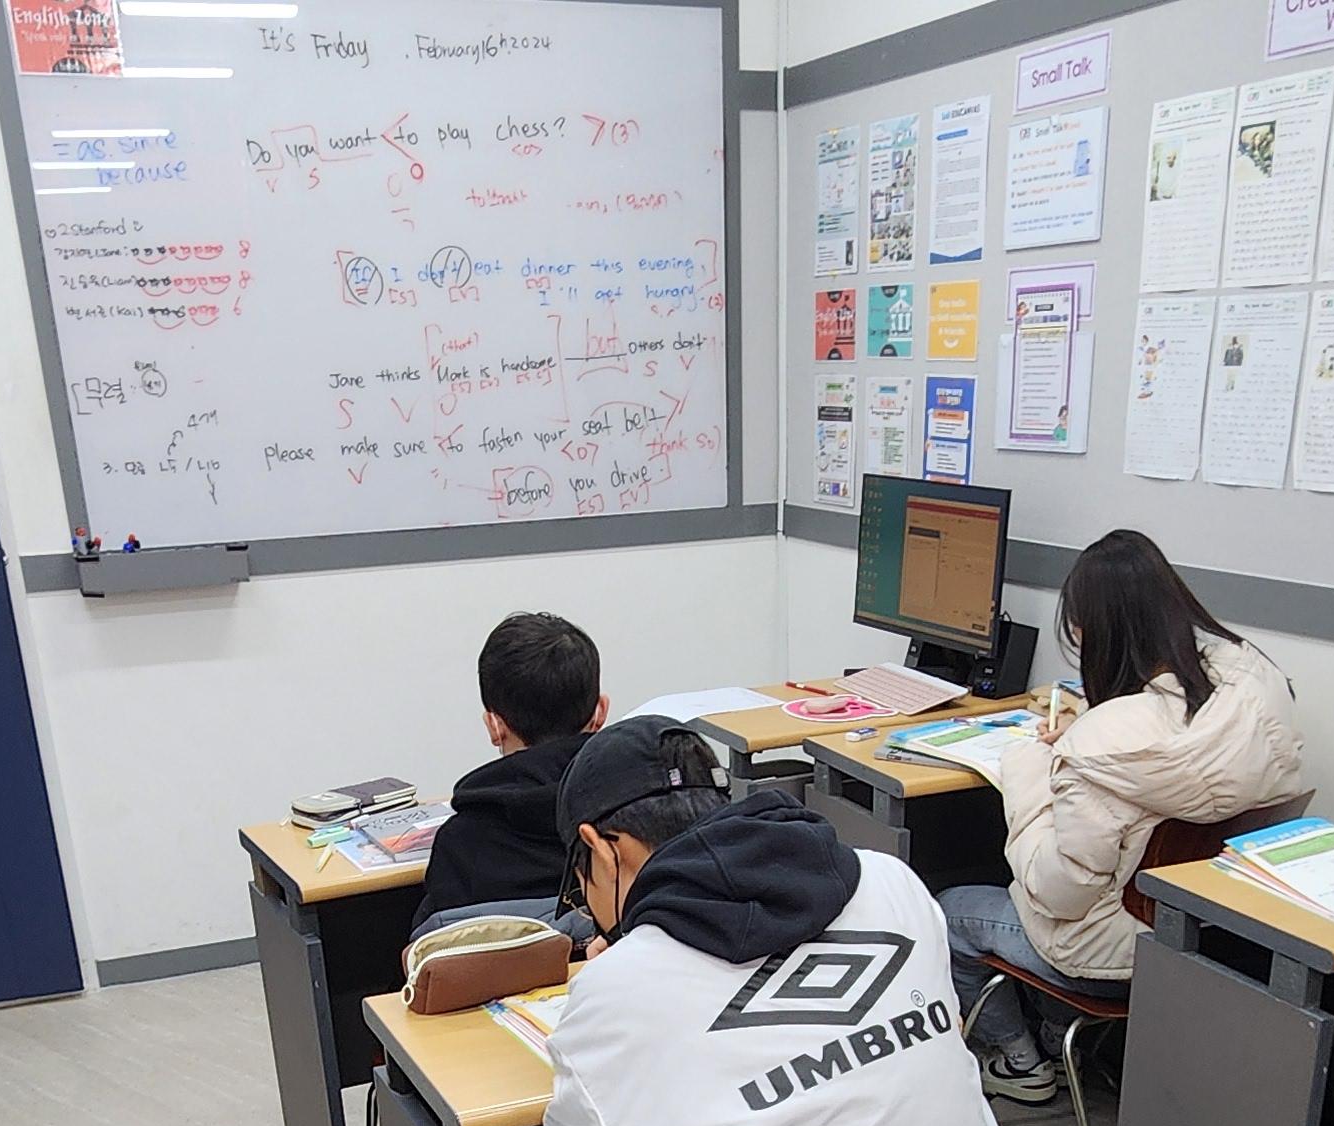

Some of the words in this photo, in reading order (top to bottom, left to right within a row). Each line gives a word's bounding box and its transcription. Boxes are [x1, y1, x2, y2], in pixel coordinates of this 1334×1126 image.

[12, 7, 70, 31] English
[258, 26, 296, 52] It's
[310, 31, 370, 68] Friday
[1031, 64, 1063, 88] Small
[1066, 57, 1092, 80] Talk
[247, 137, 272, 166] Do
[286, 142, 316, 167] you
[328, 127, 377, 152] want
[393, 126, 419, 145] to
[437, 122, 472, 149] play
[496, 114, 566, 142] chess?
[474, 261, 503, 275] eat
[521, 259, 576, 278] dinner
[590, 258, 623, 274] this
[329, 372, 366, 390] Jane
[376, 366, 421, 383] thinks
[479, 365, 491, 380] is
[501, 354, 556, 374] handsome
[340, 438, 379, 458] make
[394, 439, 427, 458] sure
[478, 428, 523, 455] fasten
[533, 429, 568, 456] your
[582, 413, 615, 435] seat
[506, 471, 553, 506] before
[569, 474, 598, 493] you
[738, 999, 952, 1111] UMBRO
